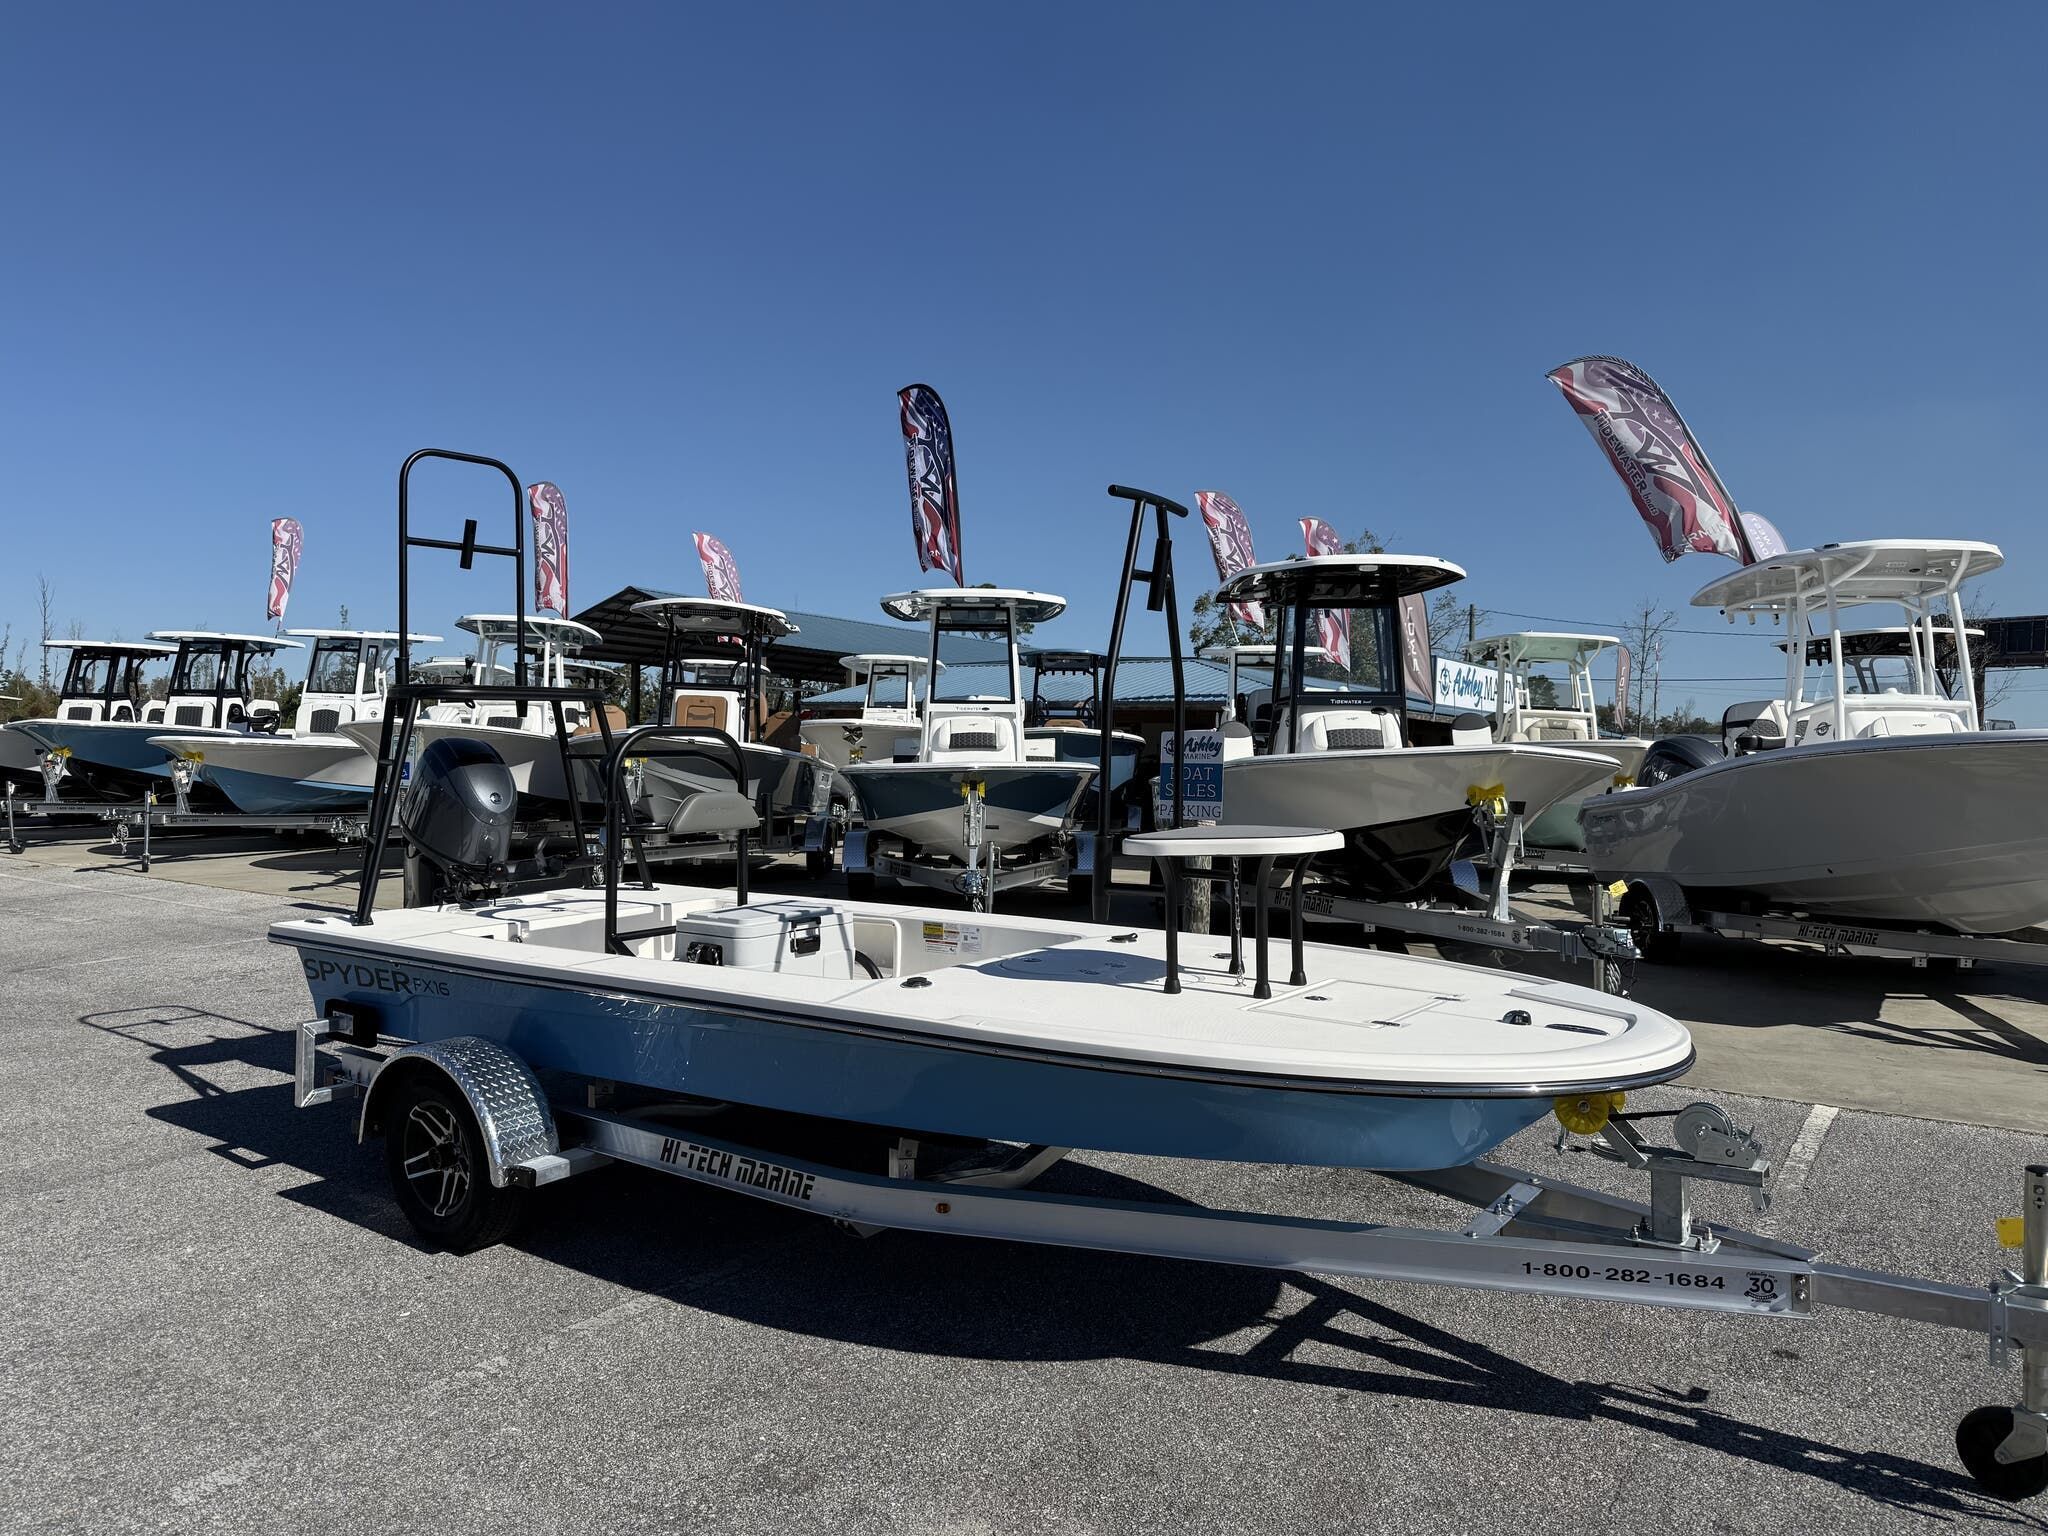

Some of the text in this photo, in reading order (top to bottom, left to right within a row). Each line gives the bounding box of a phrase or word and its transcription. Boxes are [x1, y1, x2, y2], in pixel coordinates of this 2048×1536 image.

[907, 432, 920, 509] TIDEWATER
[1593, 408, 1660, 516] TIDEWATER boats
[707, 561, 720, 600] TIDEWATE
[1453, 667, 1520, 707] Ashley MAIN
[1184, 735, 1223, 758] Ashley
[1165, 783, 1216, 798] SLES
[1303, 895, 1334, 914] MARINE
[1798, 924, 1879, 945] HI-TECH MARINE
[303, 958, 450, 996] SPYDER FX16
[660, 1138, 816, 1201] HI-TECH MARINE
[1522, 1261, 1726, 1290] 1-800-282-1684
